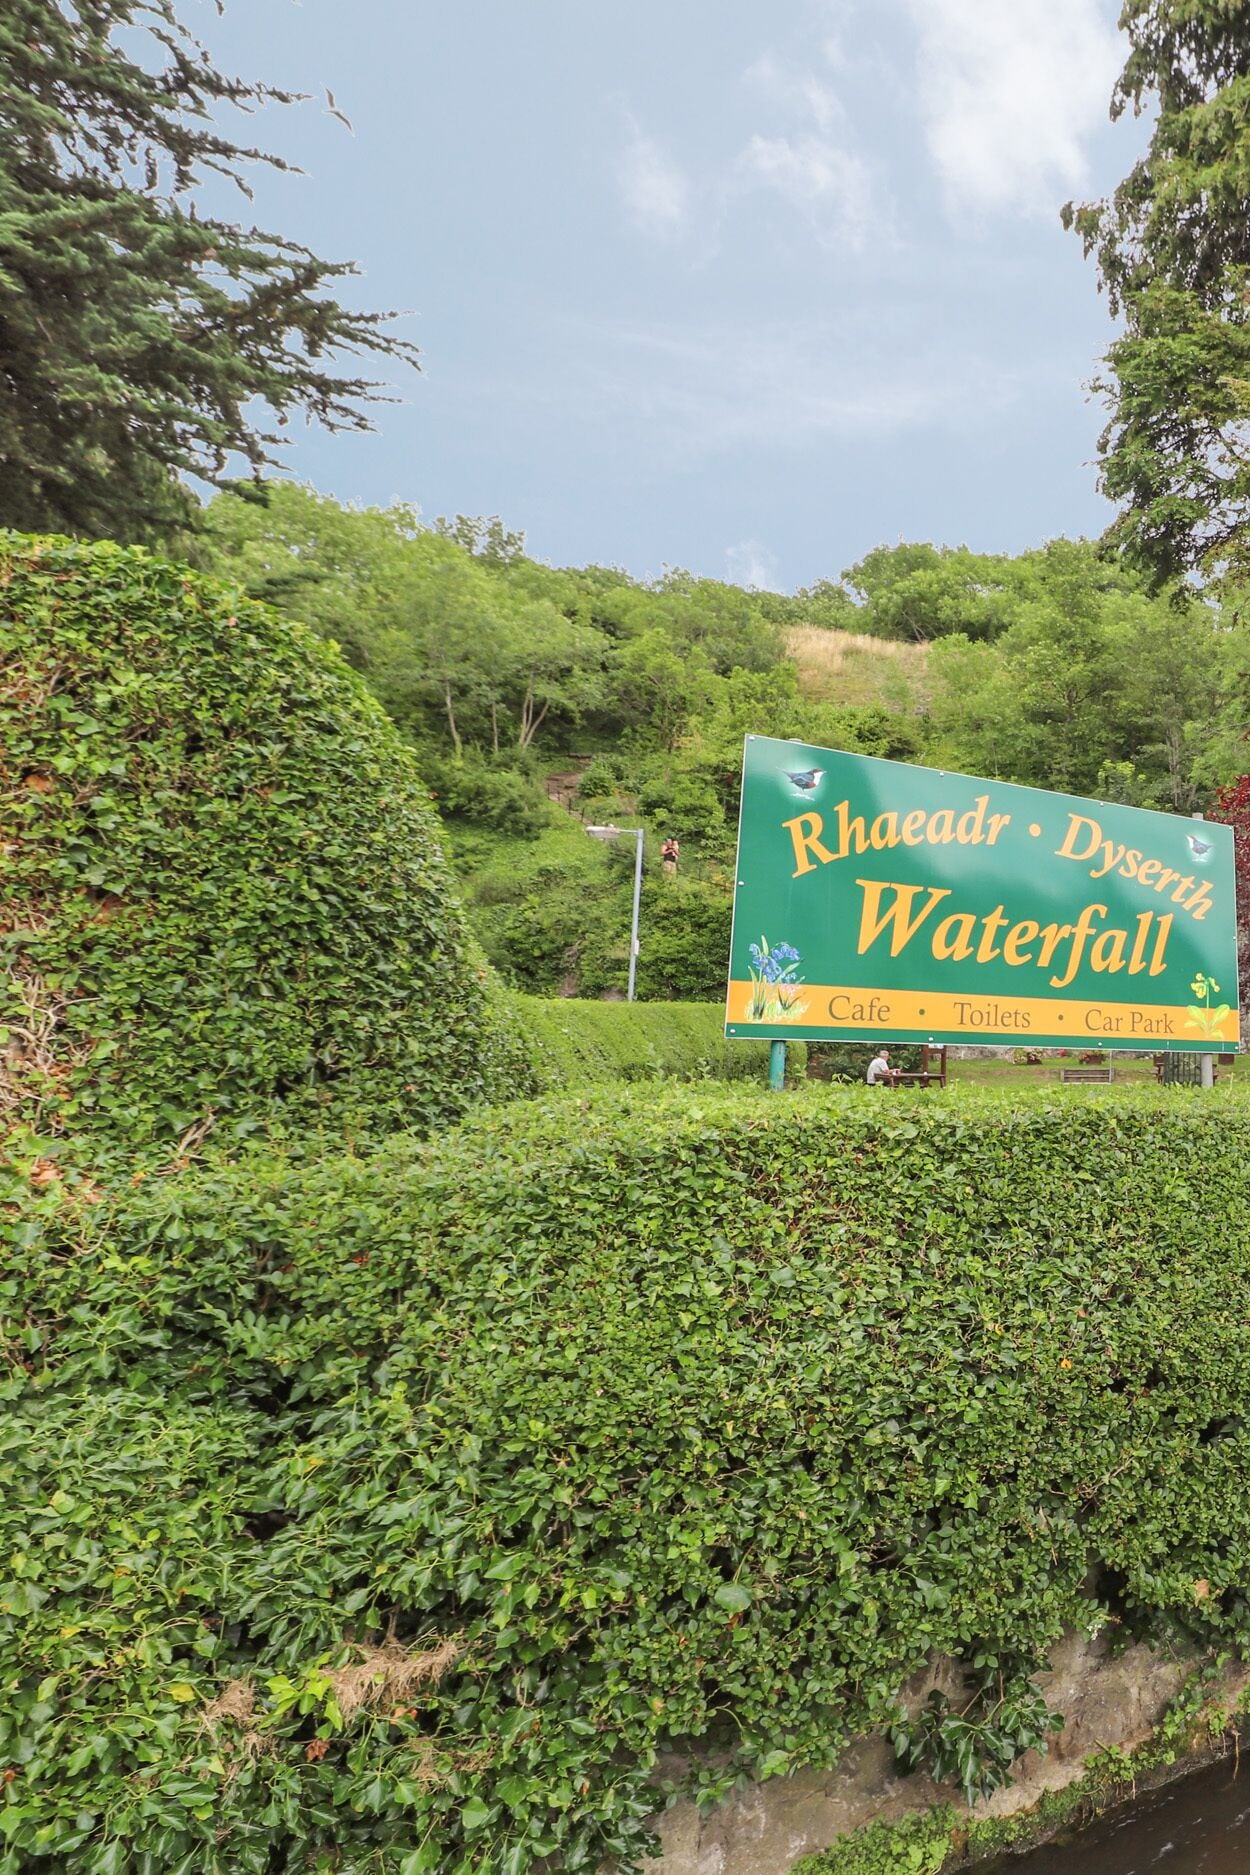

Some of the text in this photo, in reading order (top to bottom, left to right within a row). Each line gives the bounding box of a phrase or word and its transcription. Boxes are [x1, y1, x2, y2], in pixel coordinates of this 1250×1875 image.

[783, 795, 1213, 919] Rhaeadr Dyserth
[856, 879, 1174, 988] Waterfall
[828, 995, 1175, 1035] Cafe Toilets Car Park
